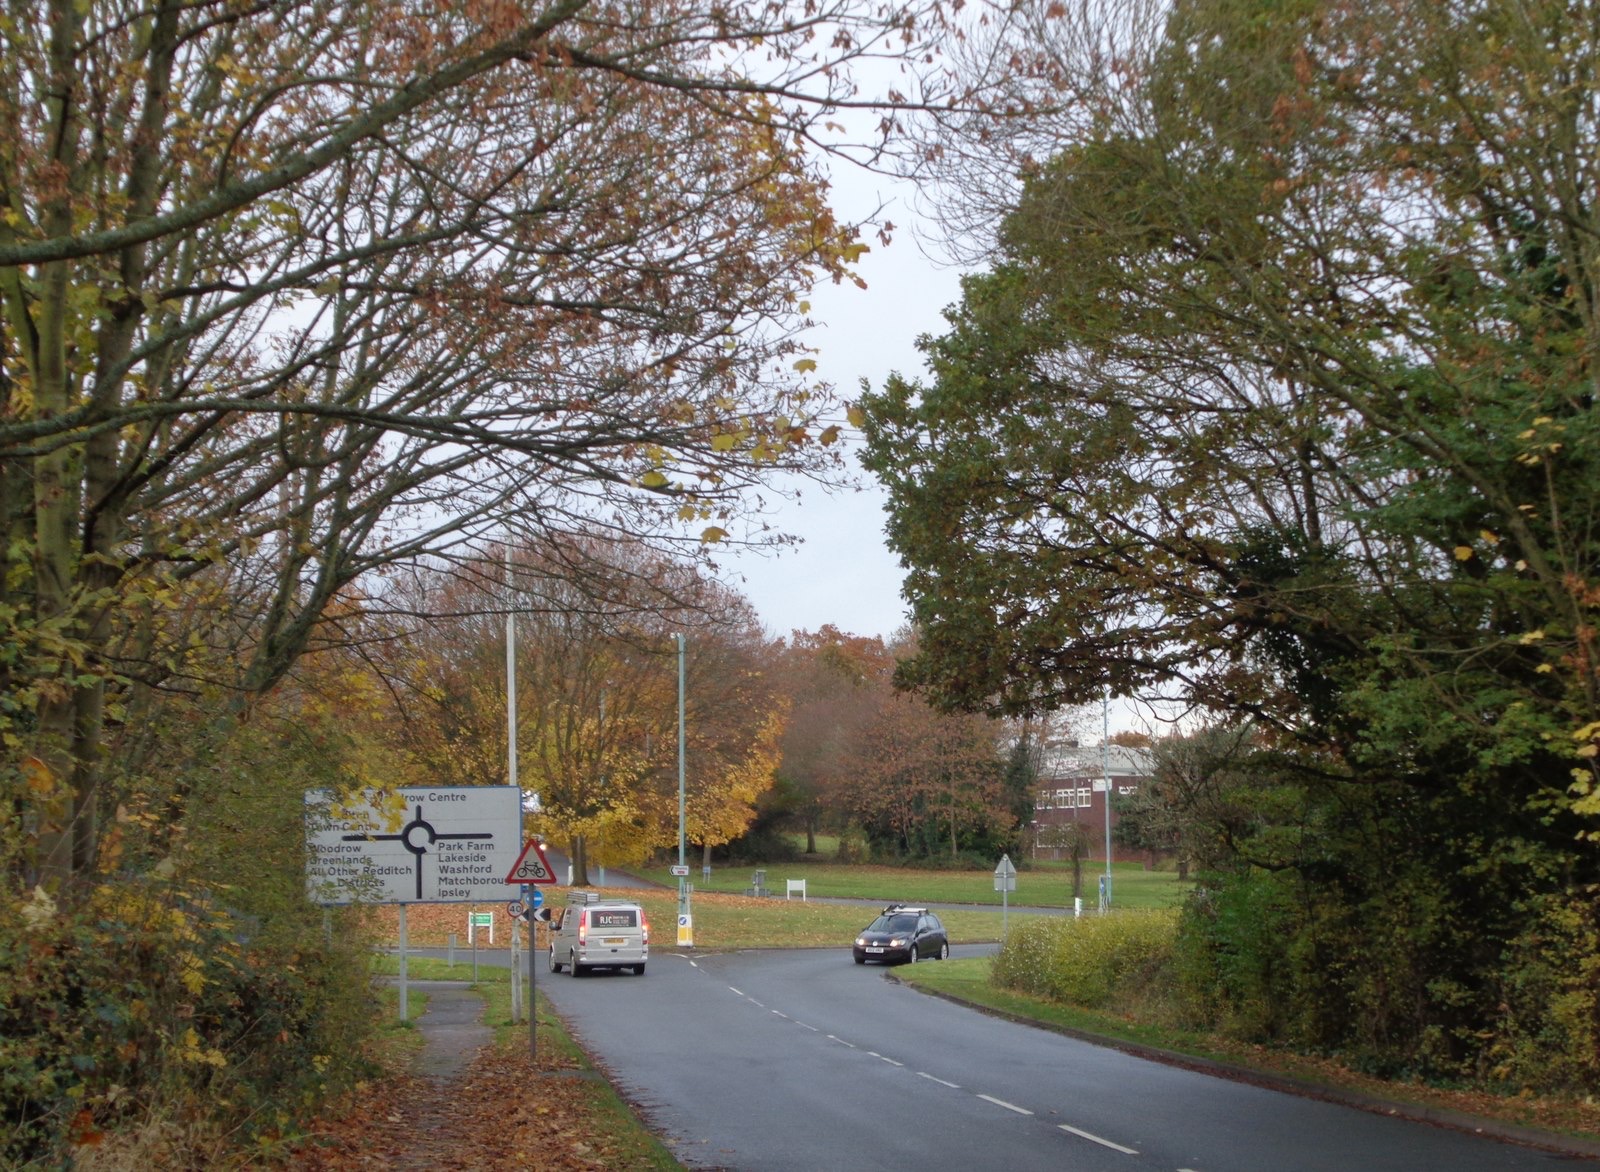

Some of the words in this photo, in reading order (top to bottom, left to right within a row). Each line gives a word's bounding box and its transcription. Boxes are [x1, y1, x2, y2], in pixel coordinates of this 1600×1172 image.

[429, 792, 467, 802] Centre
[342, 822, 380, 831] Cntr
[438, 842, 463, 851] Park
[467, 841, 494, 851] Farm
[309, 855, 372, 865] Greenlands
[438, 853, 486, 862] Lakeside
[328, 866, 359, 876] Other
[363, 866, 412, 876] Redditch
[438, 864, 492, 874] Washford
[337, 877, 385, 887] Districts
[438, 888, 471, 898] Ipsley
[600, 916, 612, 924] RJC
